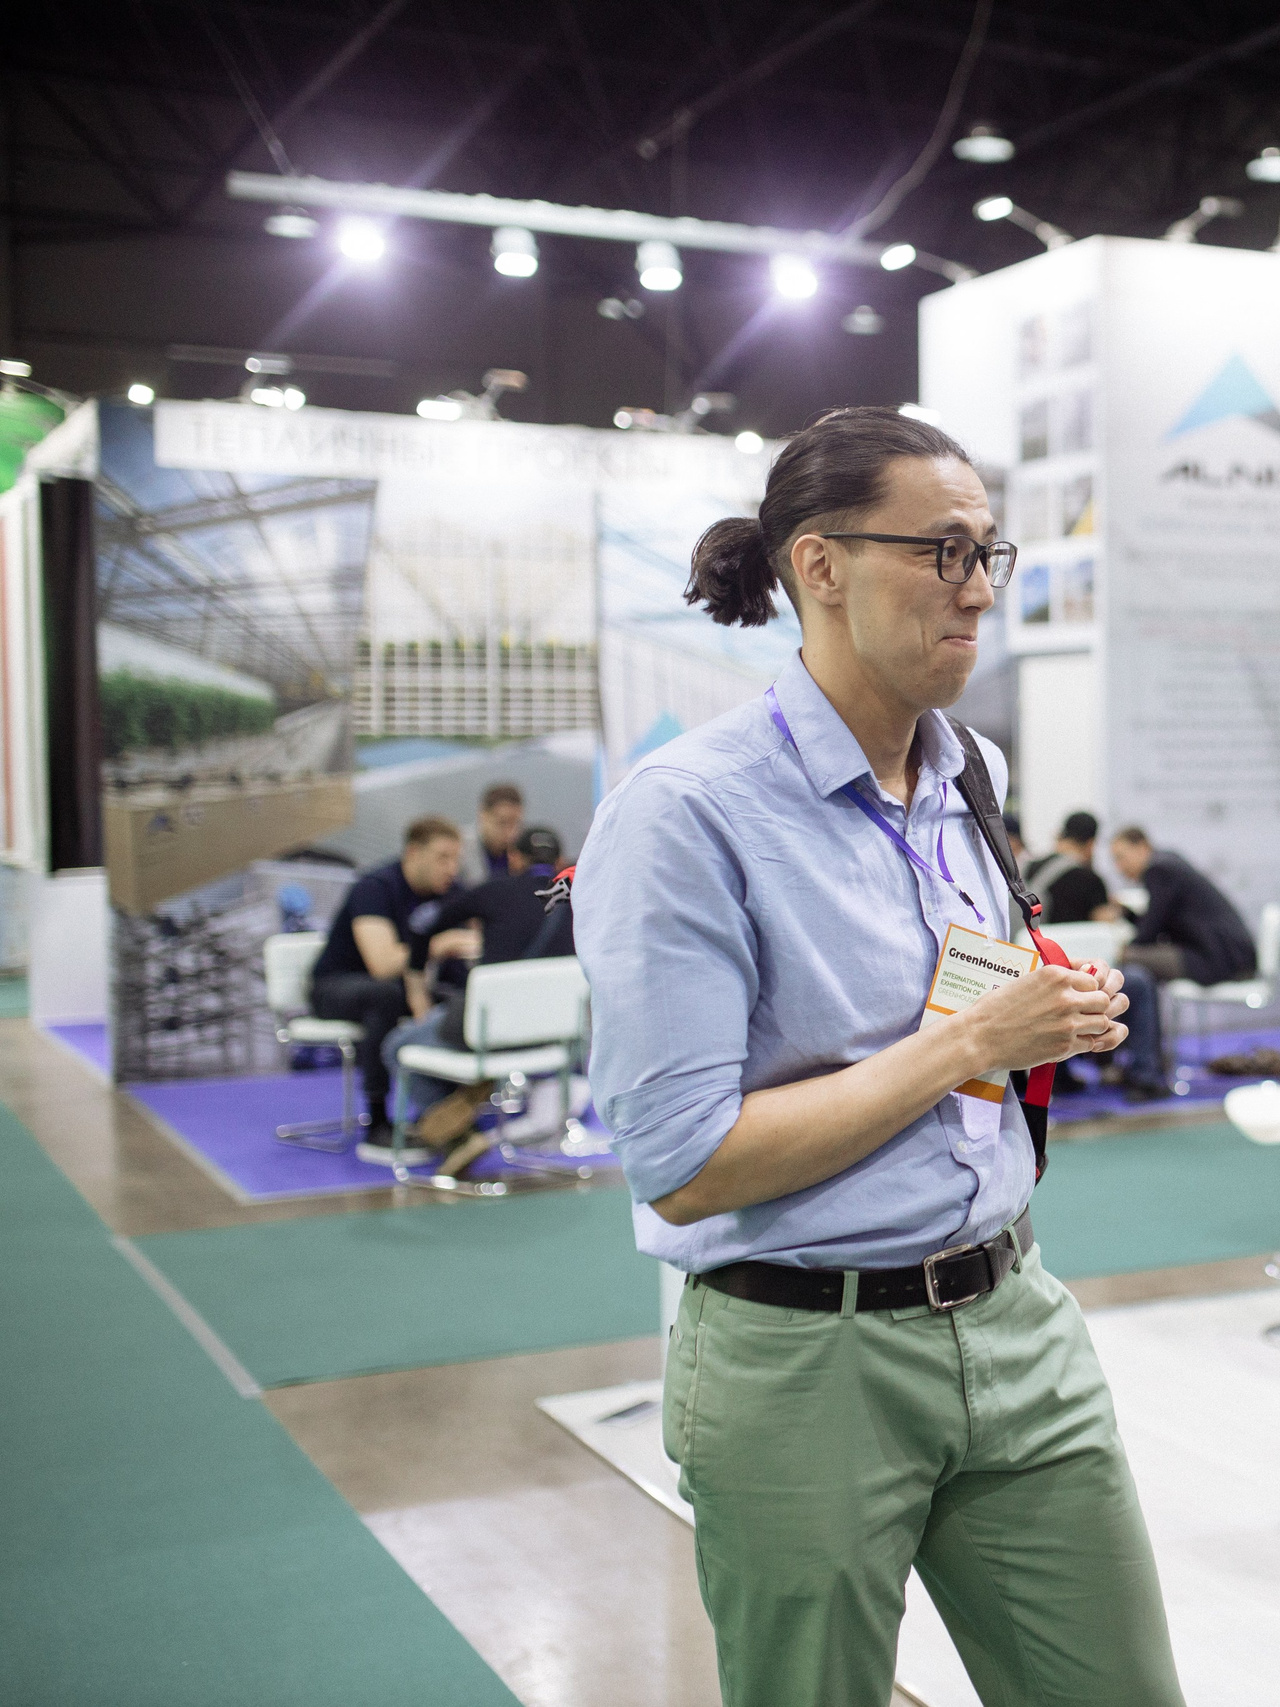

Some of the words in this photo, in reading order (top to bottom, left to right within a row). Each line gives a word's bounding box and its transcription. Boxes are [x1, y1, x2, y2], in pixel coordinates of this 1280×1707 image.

[949, 947, 1020, 978] GreenHouses
[940, 978, 972, 994] EXHIBITION
[972, 989, 982, 997] OF
[942, 970, 987, 990] INTERNATIONAL
